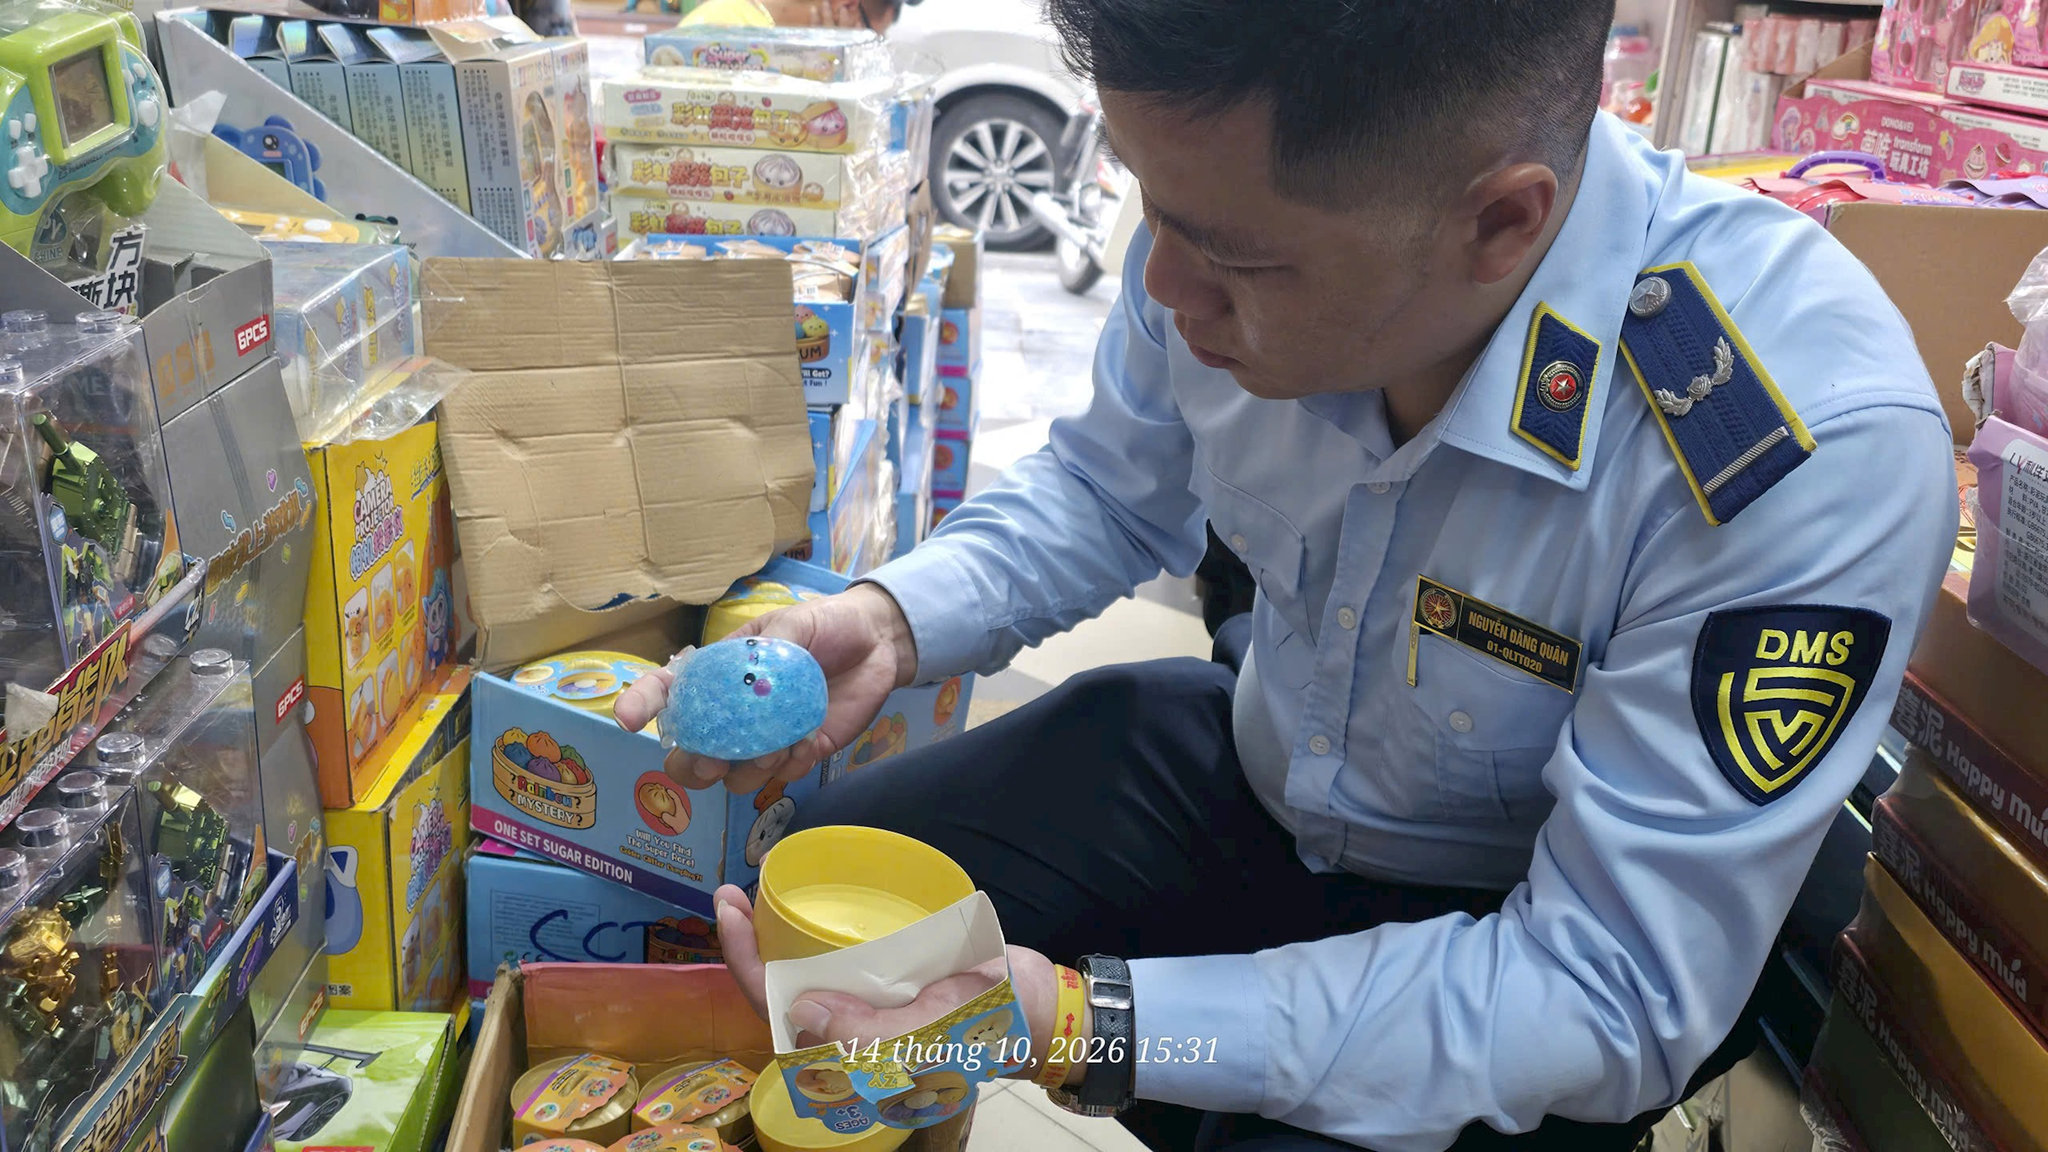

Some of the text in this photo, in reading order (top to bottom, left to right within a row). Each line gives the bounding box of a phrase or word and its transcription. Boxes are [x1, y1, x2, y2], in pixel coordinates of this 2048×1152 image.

[237, 320, 268, 350] 6PCS
[812, 369, 830, 378] Get?
[354, 476, 392, 524] CAMERA
[355, 496, 394, 543] PROJECTOR
[1486, 640, 1543, 673] 01-QLTT020
[1509, 628, 1538, 651] ĐĂNG
[1539, 642, 1569, 667] QUÂN
[1755, 628, 1854, 665] DMS
[276, 680, 304, 718] 6PCS
[517, 775, 573, 808] Rainbow
[1946, 738, 2004, 812] Happy
[517, 794, 574, 824] MYSTERY
[494, 820, 633, 884] ONE SET SUGAR EDITION
[627, 835, 642, 848] The
[644, 843, 669, 858] Super
[654, 836, 671, 849] You
[673, 842, 692, 857] Find
[1923, 879, 1979, 956] Happy
[1879, 1018, 1928, 1099] Happy
[834, 1116, 871, 1131] AGES
